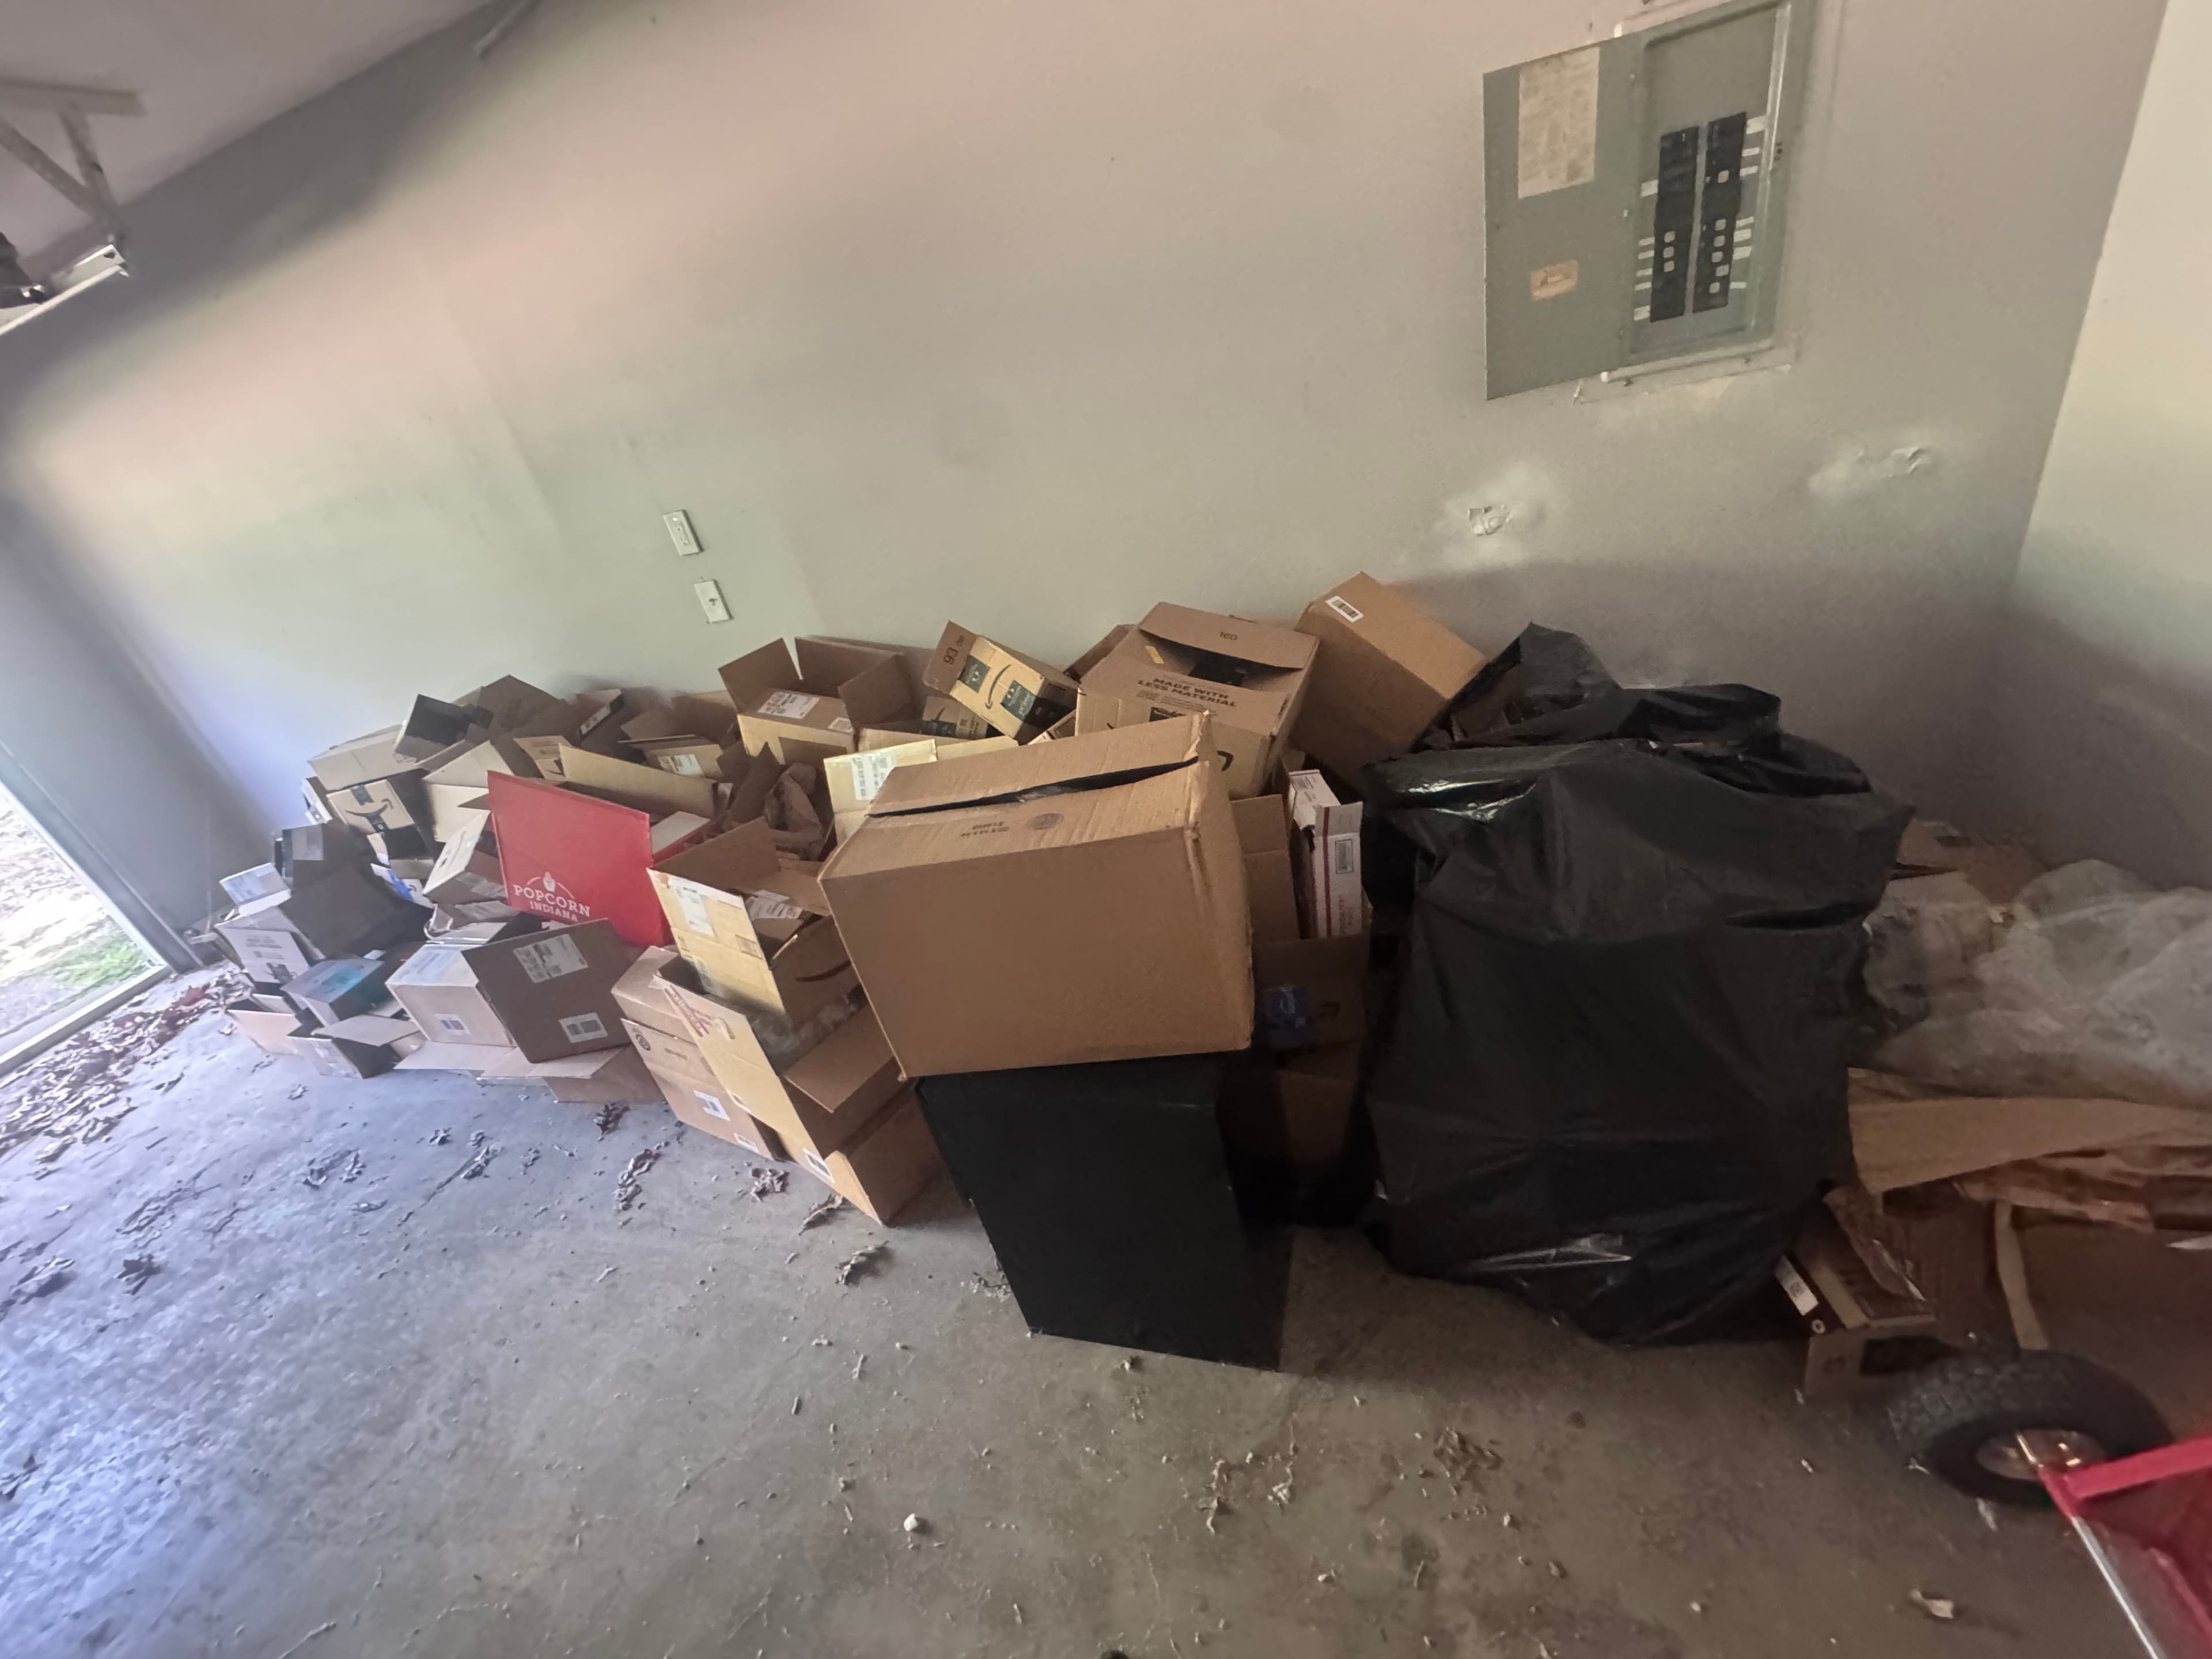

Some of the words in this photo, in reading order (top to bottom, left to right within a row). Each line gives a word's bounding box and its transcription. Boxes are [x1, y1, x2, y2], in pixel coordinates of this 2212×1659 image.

[1138, 680, 1169, 691] LESS
[1171, 688, 1237, 708] MATERIAL
[1153, 678, 1190, 691] MADE
[1194, 688, 1229, 700] WITH
[513, 884, 590, 918] POPCORN
[529, 900, 578, 922] INDIANA
